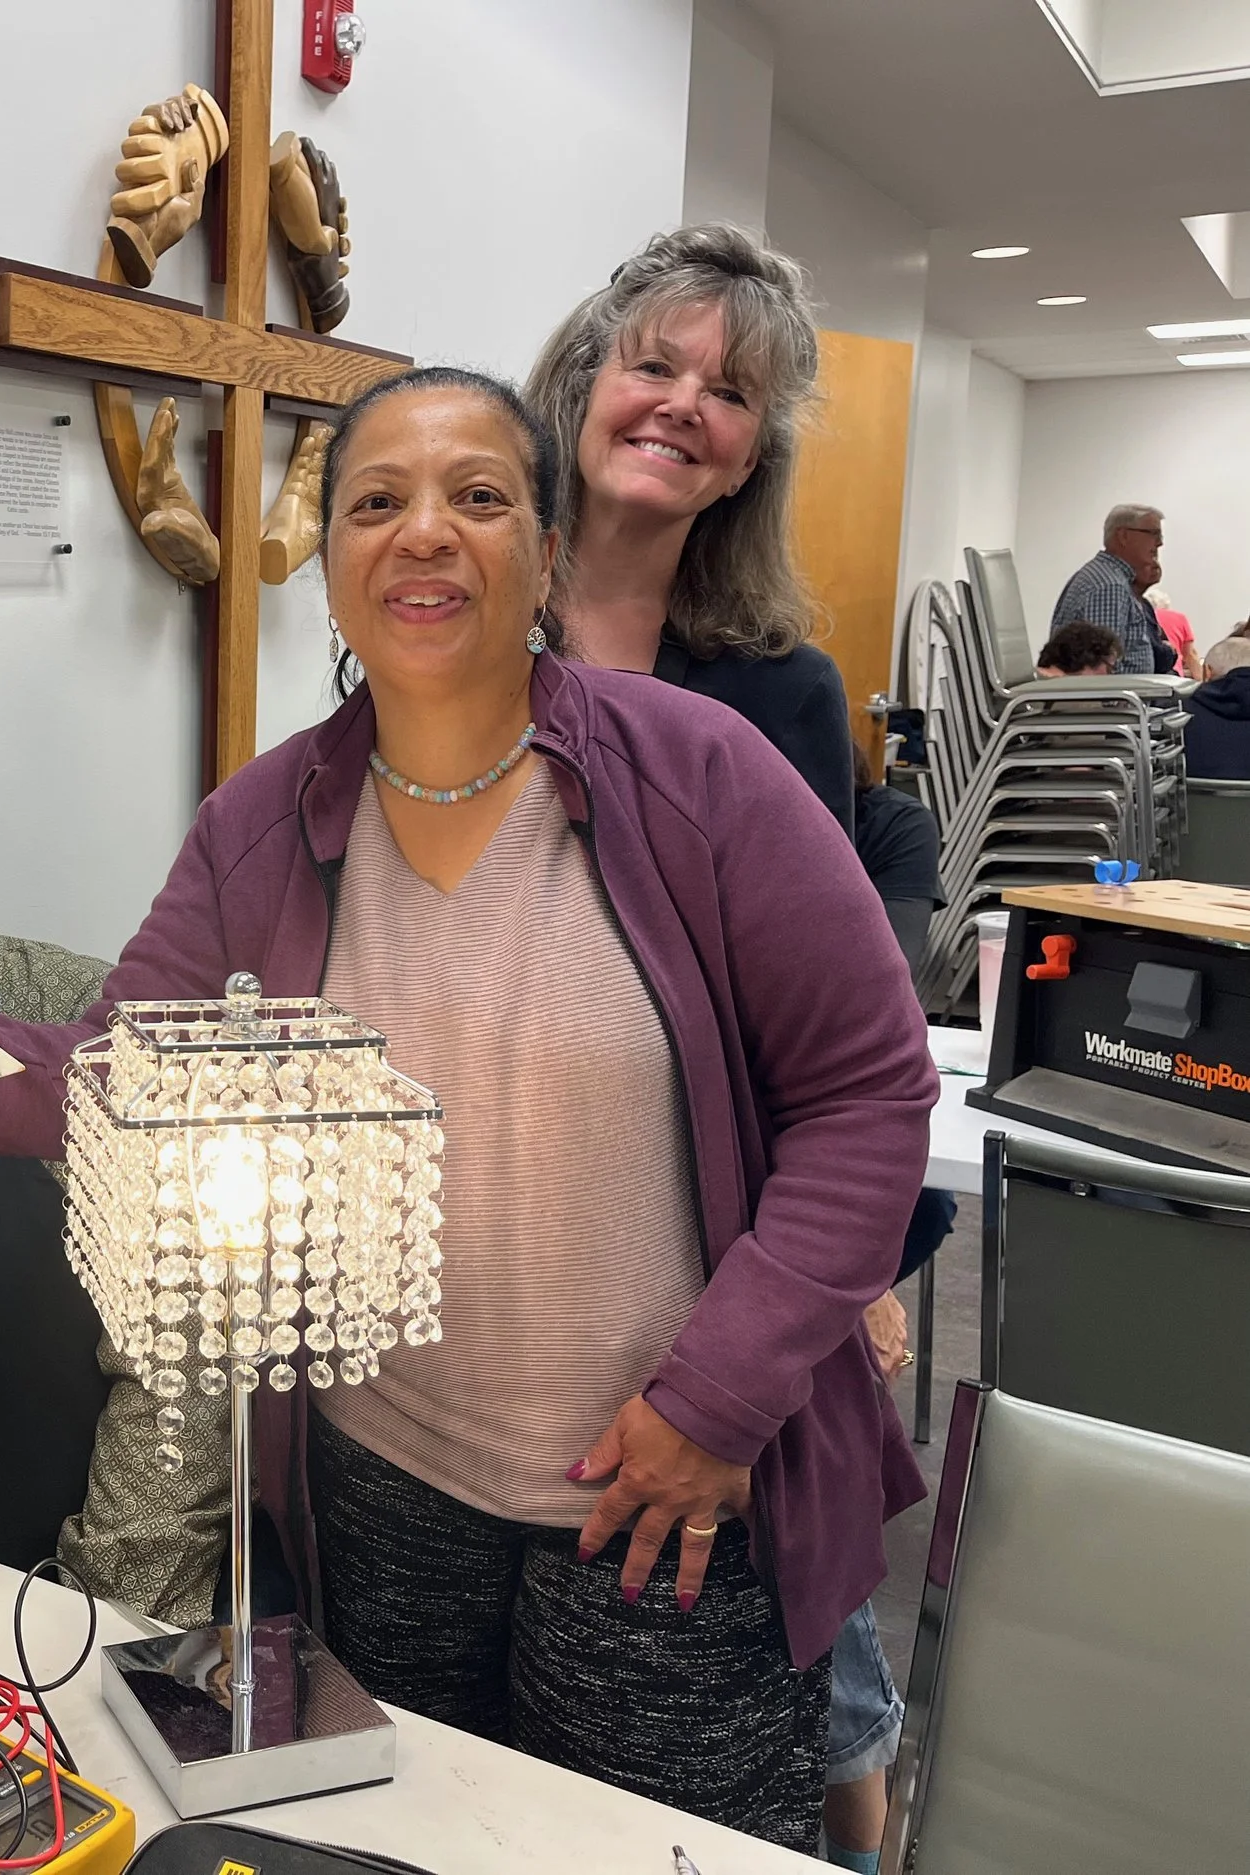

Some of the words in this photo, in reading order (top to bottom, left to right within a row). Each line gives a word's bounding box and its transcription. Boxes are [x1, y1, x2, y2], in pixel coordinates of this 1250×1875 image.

[314, 10, 324, 56] FIRE
[1085, 1030, 1172, 1073] Workmate
[1086, 1054, 1129, 1070] PORTABLE
[1132, 1065, 1170, 1080] PROJECT
[1172, 1075, 1206, 1090] CENTER
